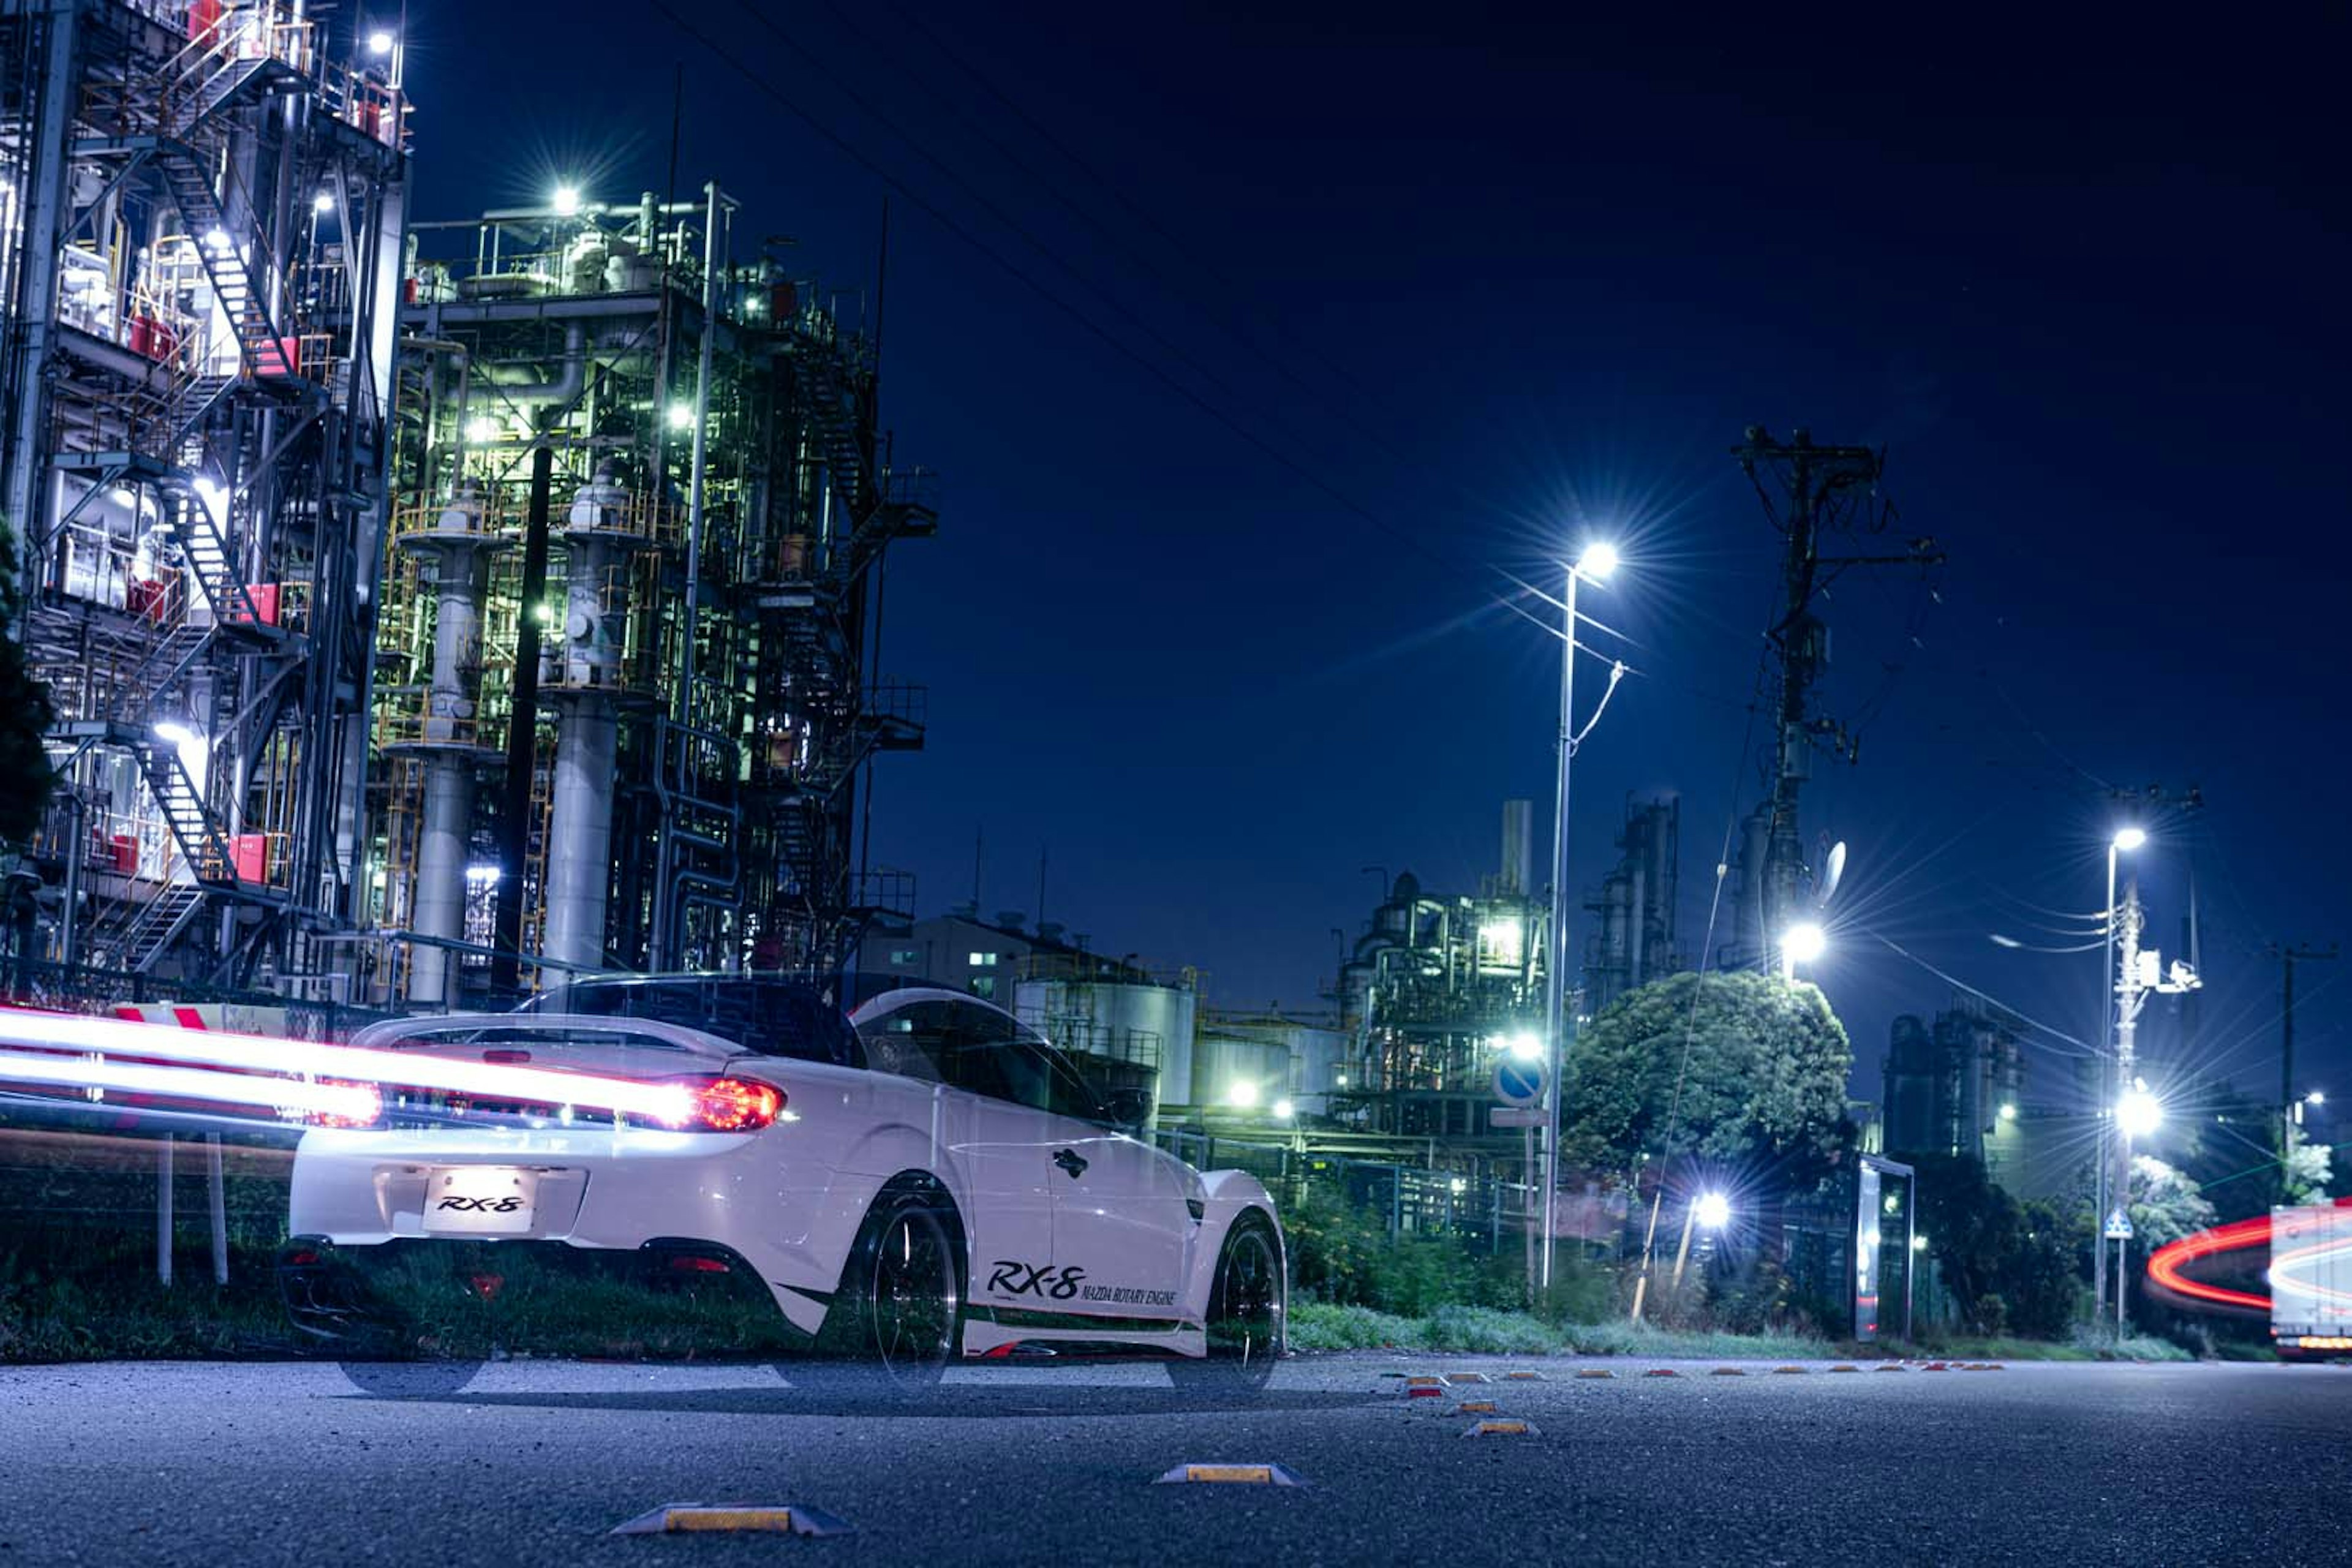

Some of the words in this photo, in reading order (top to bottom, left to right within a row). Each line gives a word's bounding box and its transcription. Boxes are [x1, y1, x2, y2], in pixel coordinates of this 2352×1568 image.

[437, 1196, 525, 1212] RX-8
[987, 1261, 1087, 1300] RX-8
[1080, 1285, 1112, 1302] MAZDA
[1146, 1290, 1176, 1305] ENGINE
